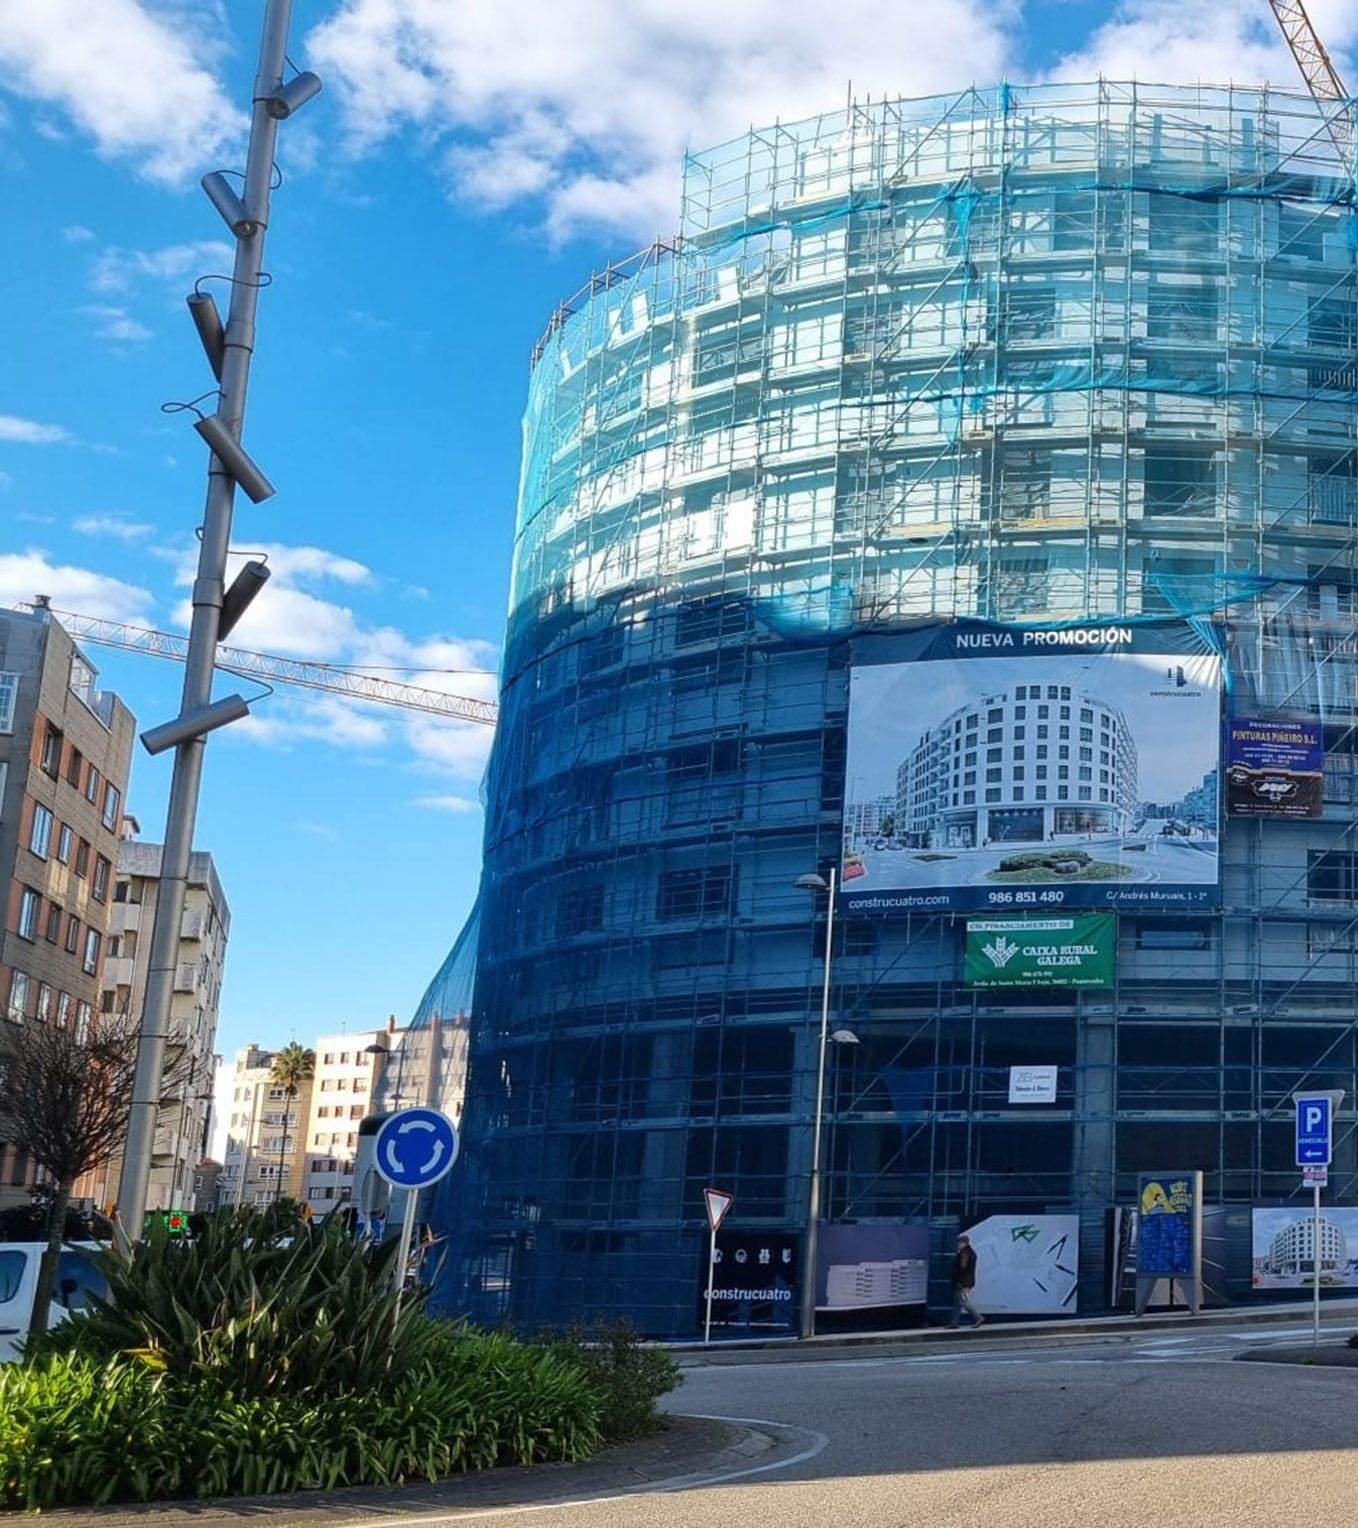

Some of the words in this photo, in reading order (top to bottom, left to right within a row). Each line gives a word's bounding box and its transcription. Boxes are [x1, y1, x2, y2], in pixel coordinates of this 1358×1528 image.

[956, 633, 1014, 648] NUEVA
[1023, 626, 1132, 646] PROMOCIÓN
[848, 895, 950, 909] construcuatro.com
[988, 892, 1013, 903] 986
[1015, 891, 1037, 902] 851
[1040, 891, 1065, 902] 480
[1022, 946, 1058, 956] CAIXA
[1060, 945, 1098, 955] RURAL
[1037, 956, 1081, 965] GALEGA
[1306, 1107, 1322, 1133] P
[703, 1287, 791, 1300] construcuatro
